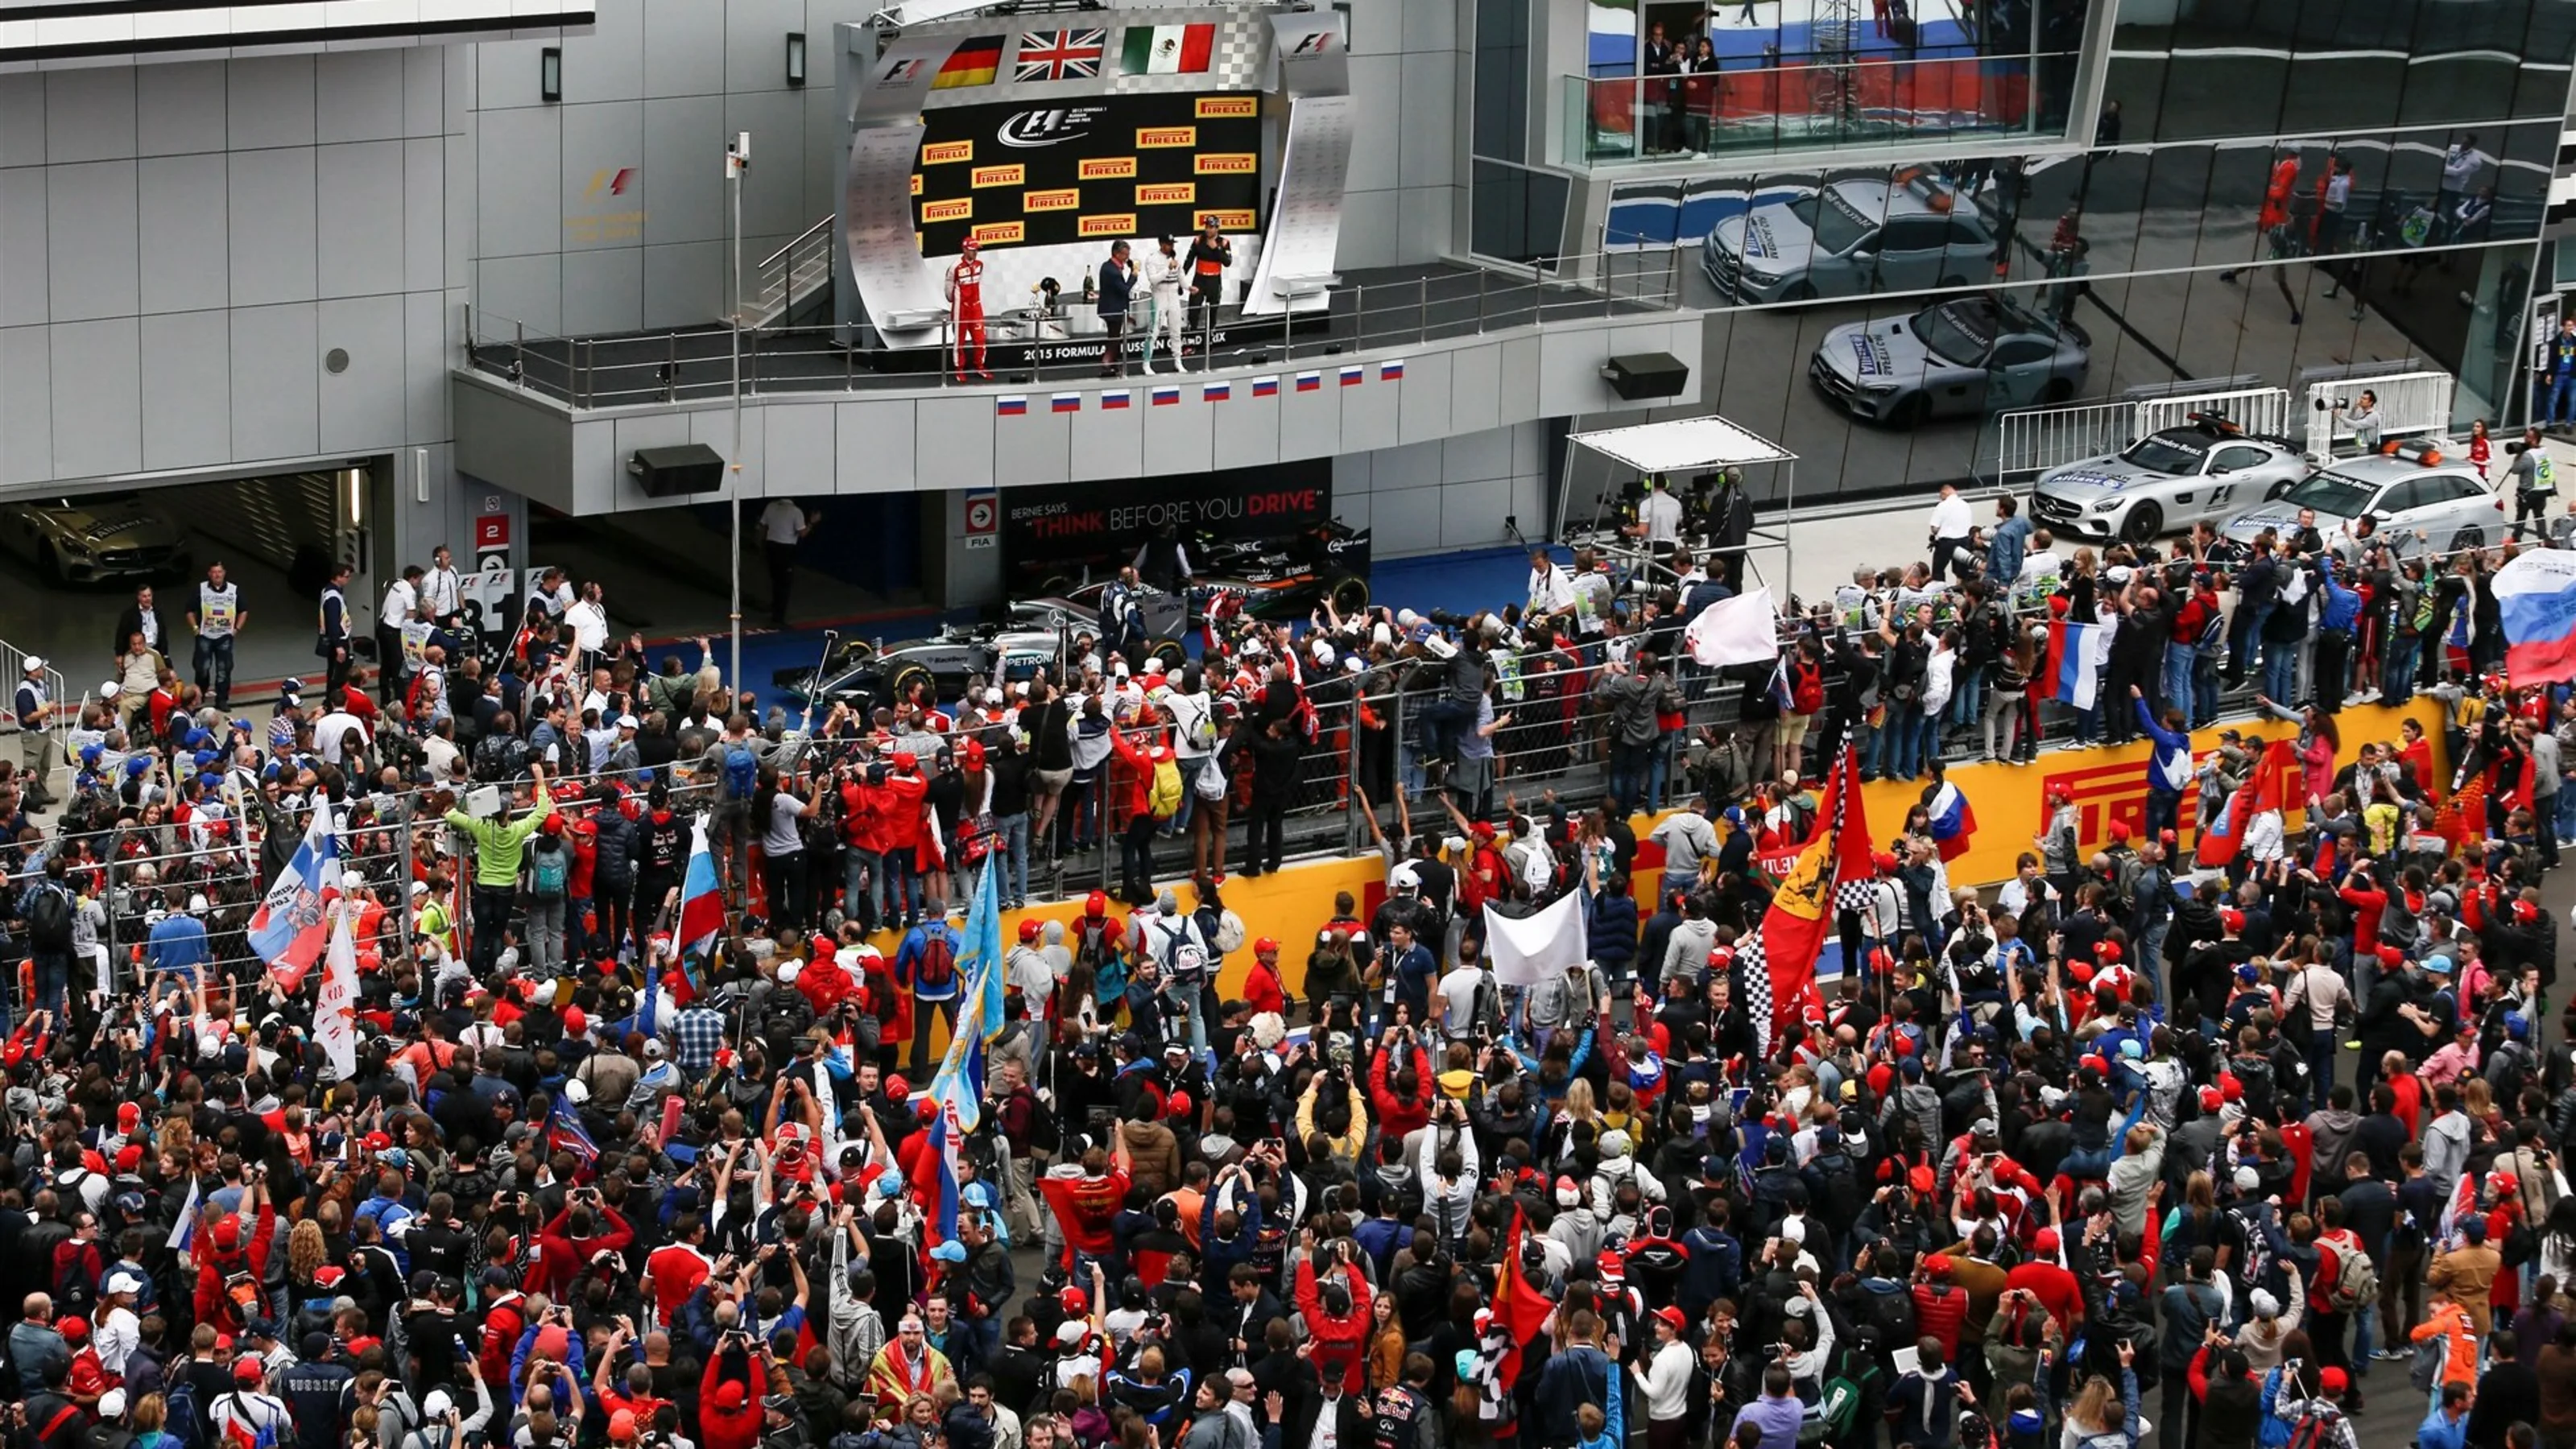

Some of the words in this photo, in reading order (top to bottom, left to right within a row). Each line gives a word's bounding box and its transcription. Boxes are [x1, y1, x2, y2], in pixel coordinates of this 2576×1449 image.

[1201, 101, 1251, 114] PIRELLI
[1141, 130, 1190, 144] PIRELLI
[927, 145, 968, 160] PIRELLI
[1083, 161, 1131, 175] PIRELLI
[1200, 157, 1250, 170] PIRELLI
[976, 169, 1019, 184] PIRELLI
[1028, 193, 1074, 208] PIRELLI
[1140, 187, 1189, 200] PIRELLI
[926, 203, 968, 218] PIRELLI
[1083, 218, 1131, 232] PIRELLI
[1199, 213, 1250, 226] PELLI
[976, 226, 1019, 241] PIRELLI
[1056, 345, 1106, 358] FORMULA
[2150, 435, 2204, 456] Mercedes-Benz
[2316, 471, 2376, 493] Mercedes-Benz
[1011, 505, 1043, 519] BERNIE
[1110, 501, 1190, 530] BEFORE
[1196, 496, 1243, 521] YOU
[486, 525, 499, 538] 2
[972, 538, 990, 547] FIA
[1234, 541, 1263, 552] NEC
[1159, 603, 1184, 613] EPSON
